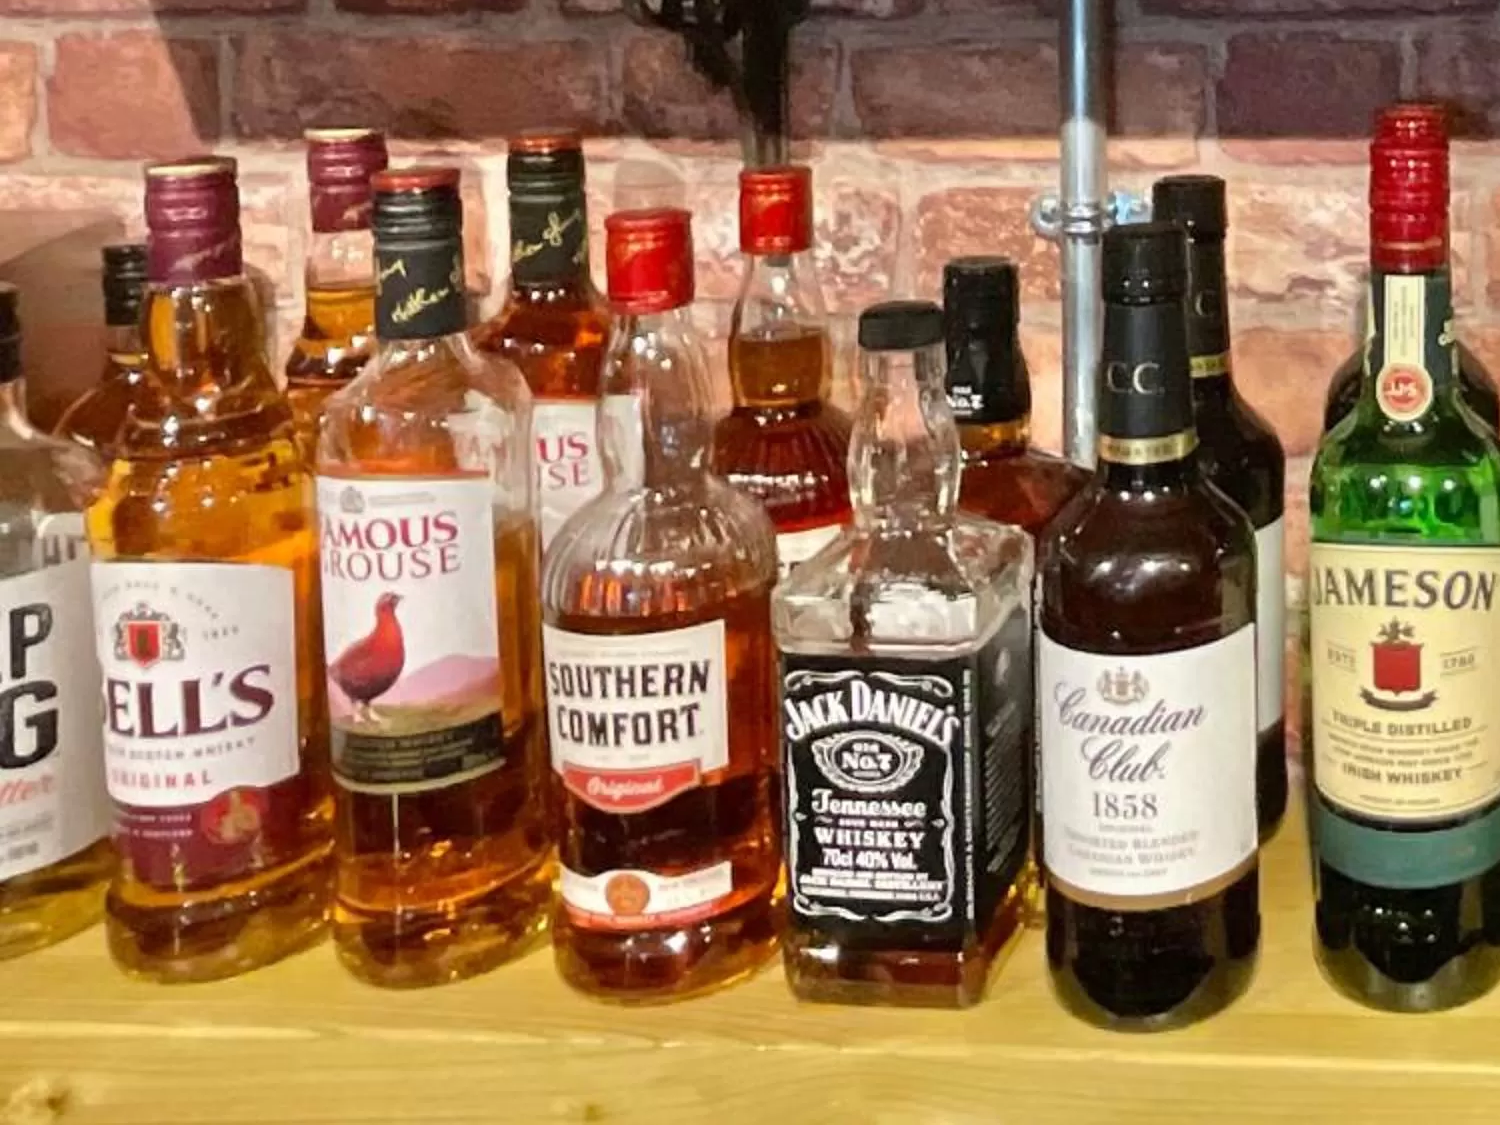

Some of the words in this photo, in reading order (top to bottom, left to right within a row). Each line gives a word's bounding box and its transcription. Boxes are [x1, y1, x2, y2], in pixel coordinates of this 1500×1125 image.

[321, 510, 459, 551] AMOUS
[324, 543, 463, 582] ROUSE
[1314, 566, 1498, 611] JAMESON
[549, 658, 711, 699] SOUTHERN
[103, 664, 277, 739] ELL'S
[784, 689, 848, 742] JACK
[850, 679, 960, 746] DANIEL'S
[1055, 680, 1206, 736] Canadian
[556, 702, 703, 748] COMFORT
[1387, 716, 1472, 736] DISTILLED
[1081, 735, 1171, 783] Club
[1387, 767, 1463, 784] WHISKEY
[586, 776, 666, 802] Original
[811, 788, 928, 819] Tennessee
[1092, 791, 1159, 820] 1858
[813, 826, 925, 850] WHISKEY
[855, 850, 889, 869] 40%
